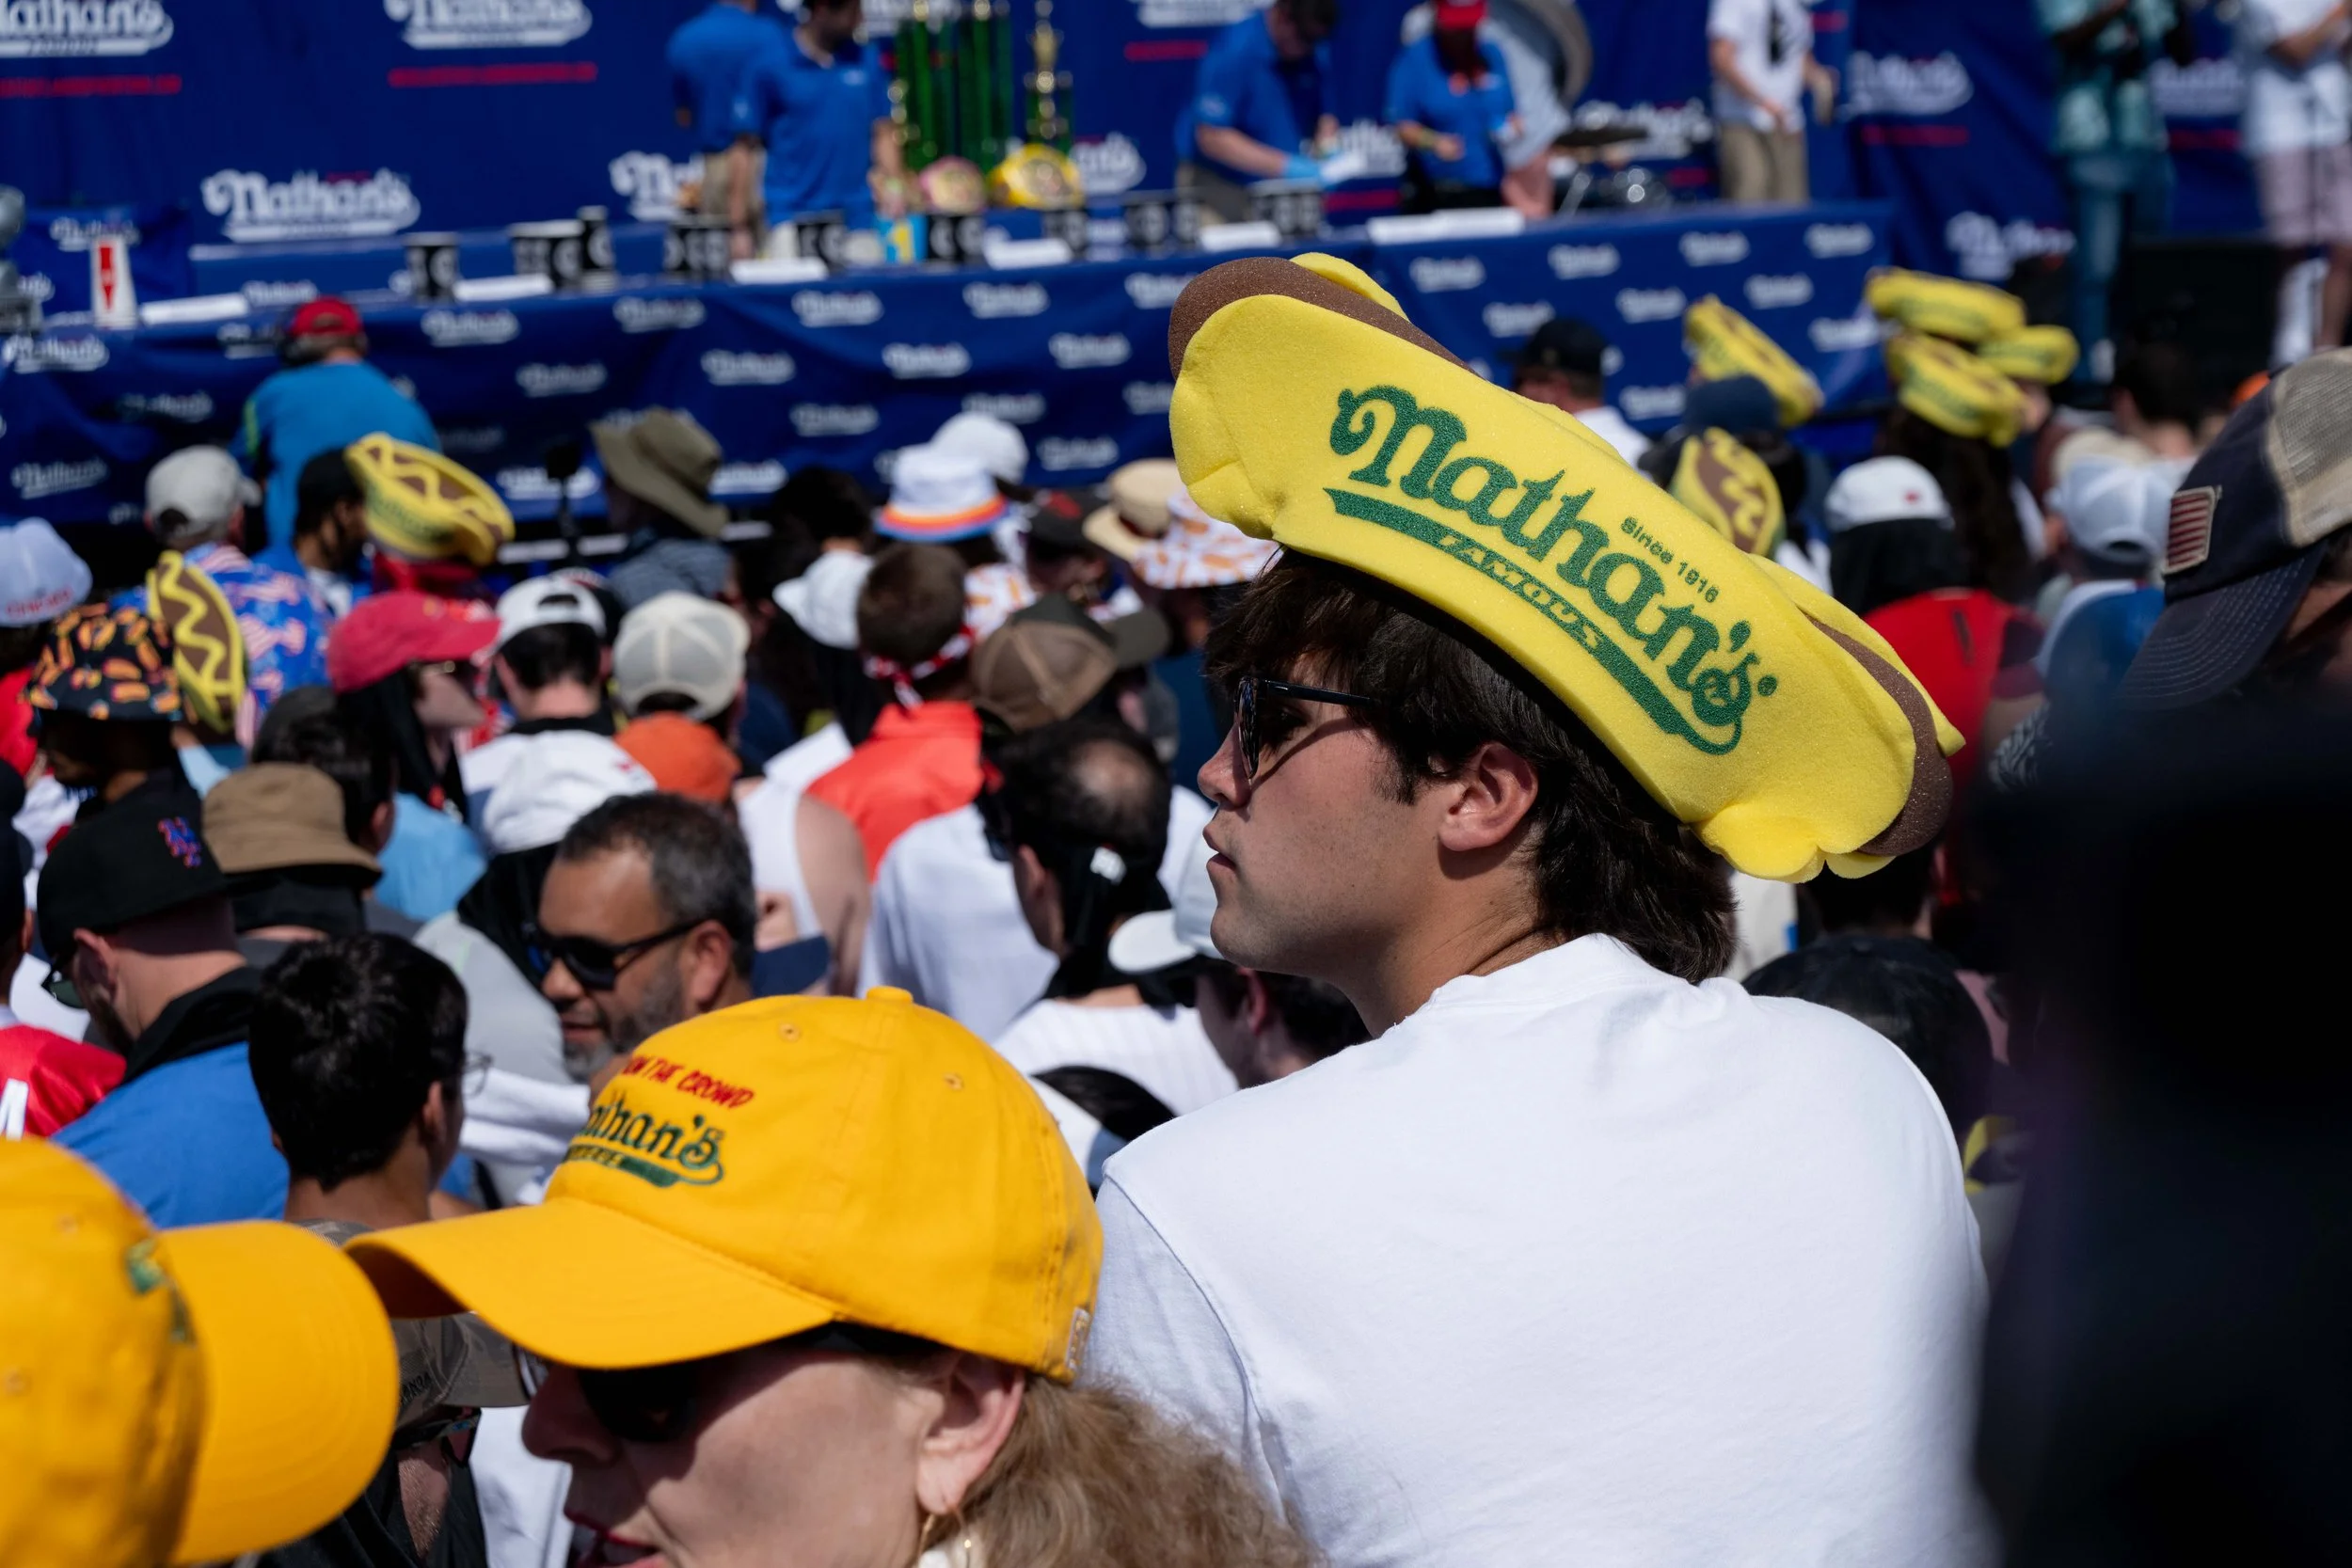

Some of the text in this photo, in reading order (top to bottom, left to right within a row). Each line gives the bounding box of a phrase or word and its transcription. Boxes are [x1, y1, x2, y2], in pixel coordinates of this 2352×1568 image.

[1329, 385, 1760, 726] Nathan's
[1438, 533, 1598, 649] FAMOUS
[1621, 516, 1719, 603] Since 1916
[675, 1069, 755, 1108] CROWD
